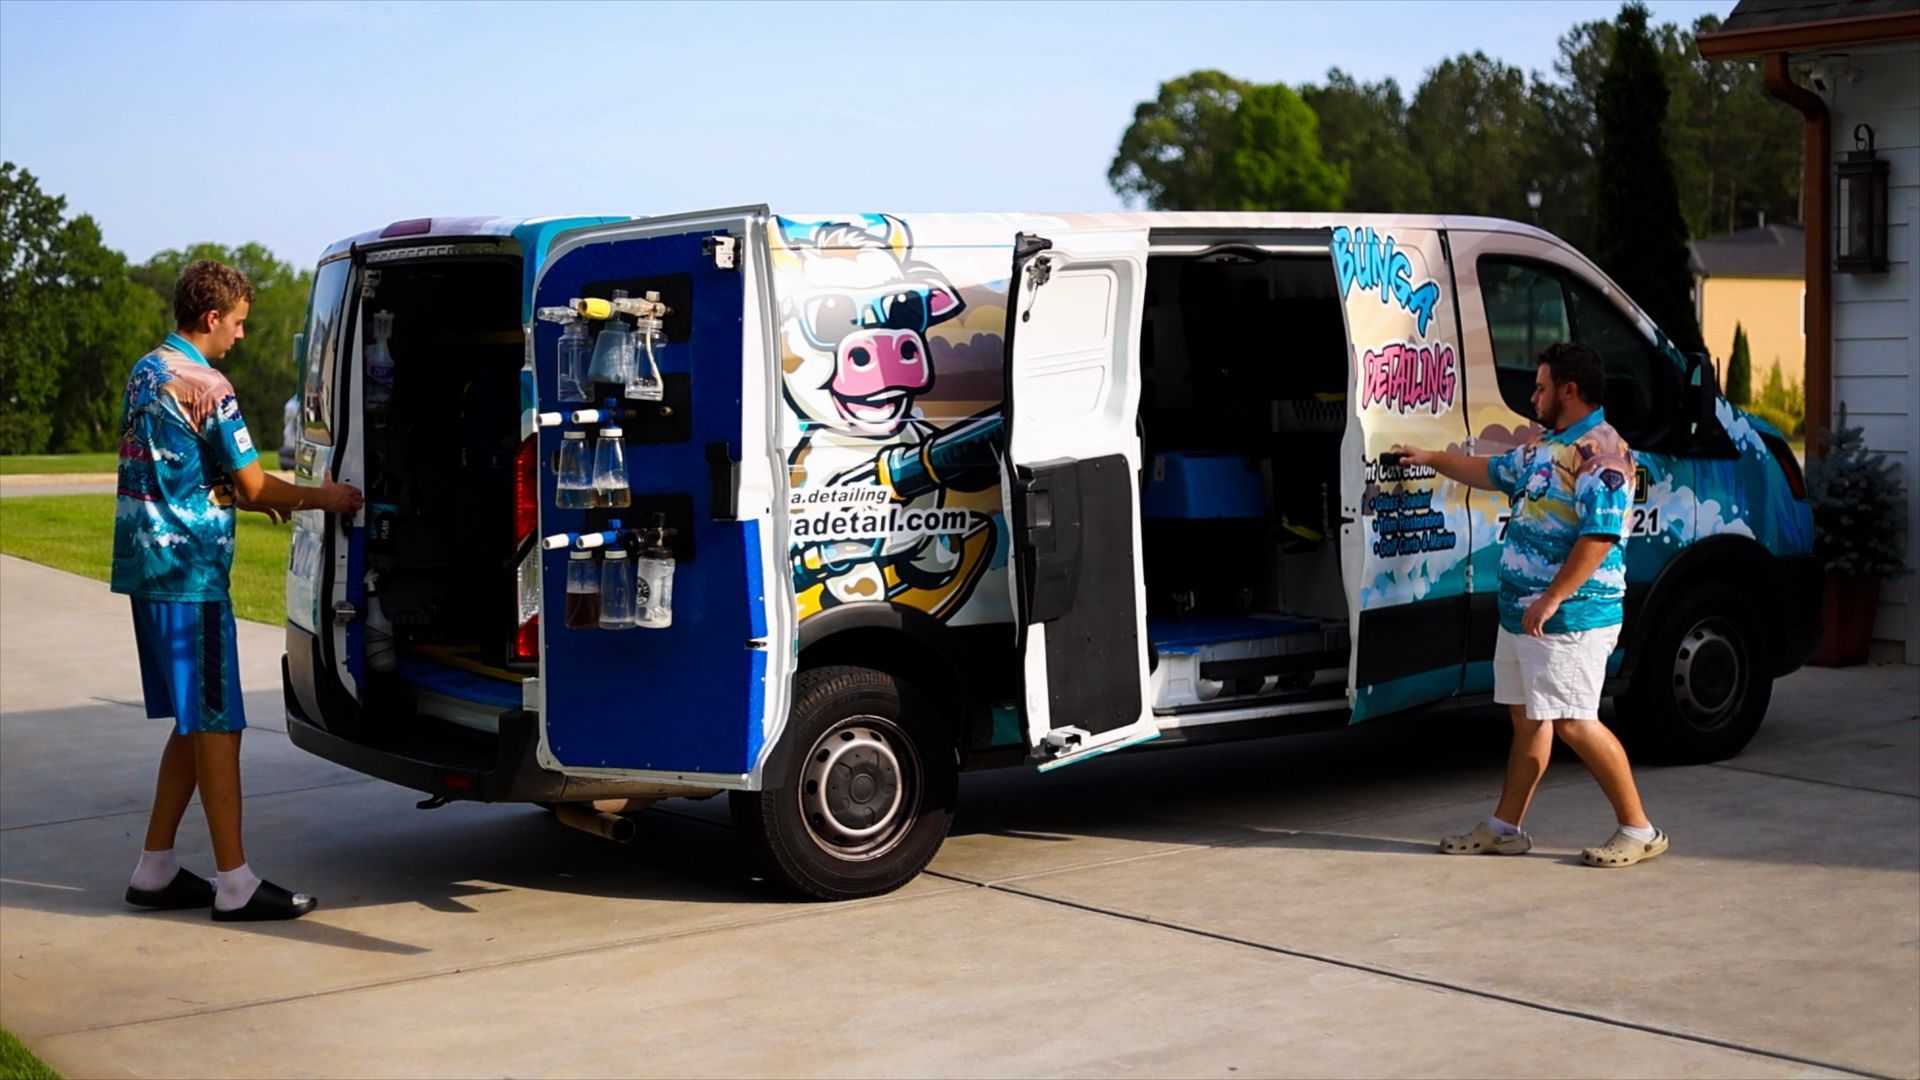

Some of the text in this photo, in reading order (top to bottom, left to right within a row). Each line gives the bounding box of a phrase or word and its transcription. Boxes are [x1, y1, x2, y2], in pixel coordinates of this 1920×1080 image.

[1333, 226, 1440, 338] BUNGA
[1362, 342, 1457, 415] DETAILING
[791, 488, 888, 504] a.detailing
[794, 508, 967, 536] adetail.com
[1631, 508, 1658, 533] 21
